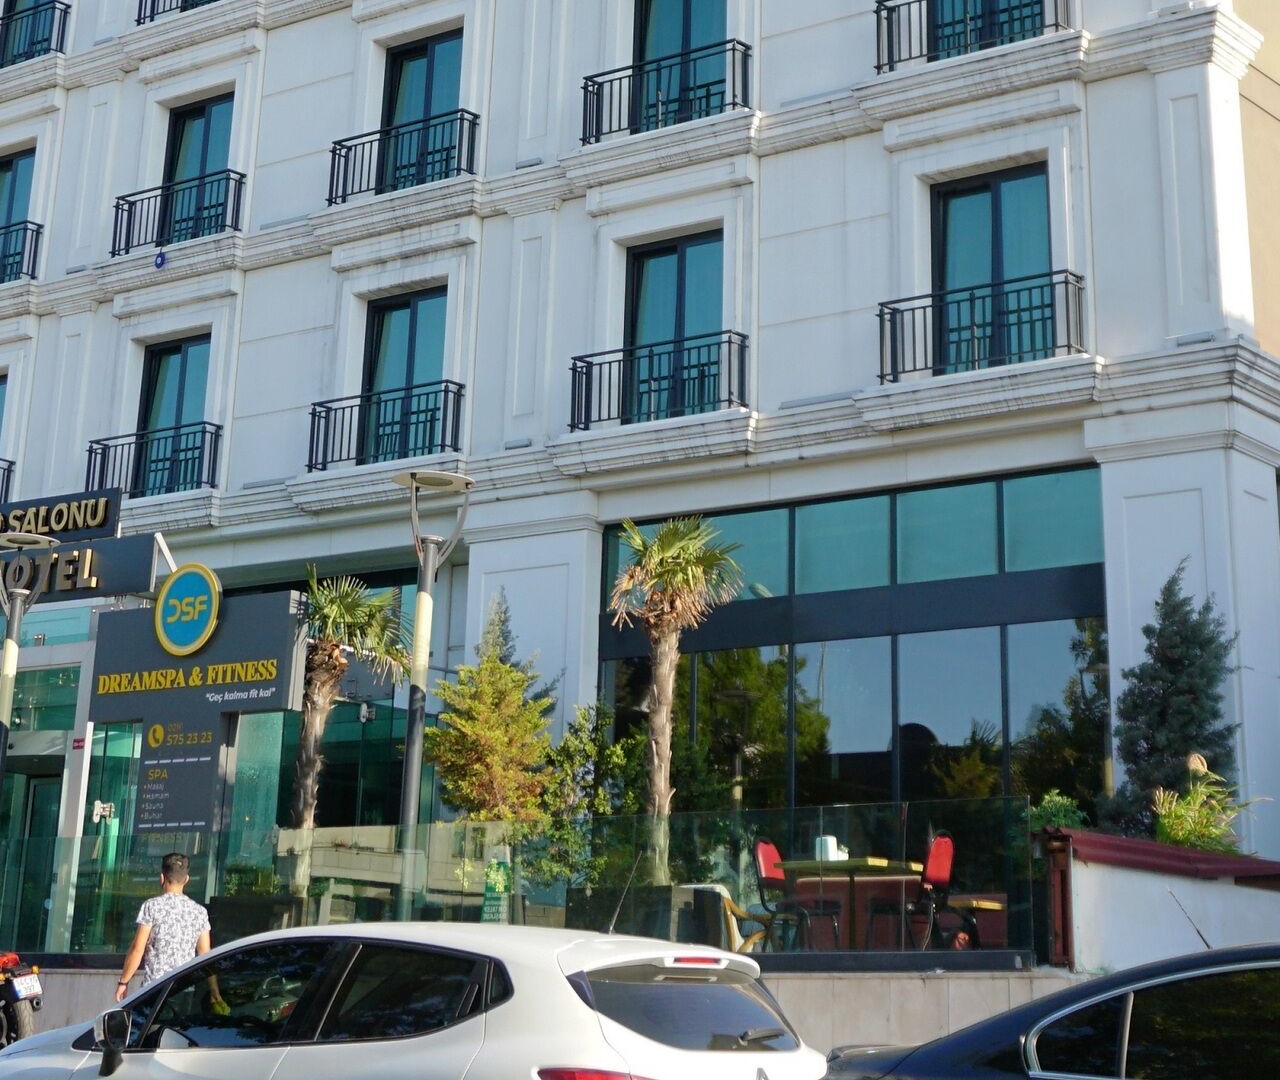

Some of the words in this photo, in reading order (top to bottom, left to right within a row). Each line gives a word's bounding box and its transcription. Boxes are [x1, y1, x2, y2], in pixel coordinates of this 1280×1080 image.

[8, 498, 108, 534] SALONU
[167, 595, 208, 623] DSF
[97, 667, 186, 695] DREAMSPA
[189, 666, 203, 686] &
[206, 659, 278, 685] FITNESS
[148, 768, 169, 780] SPA
